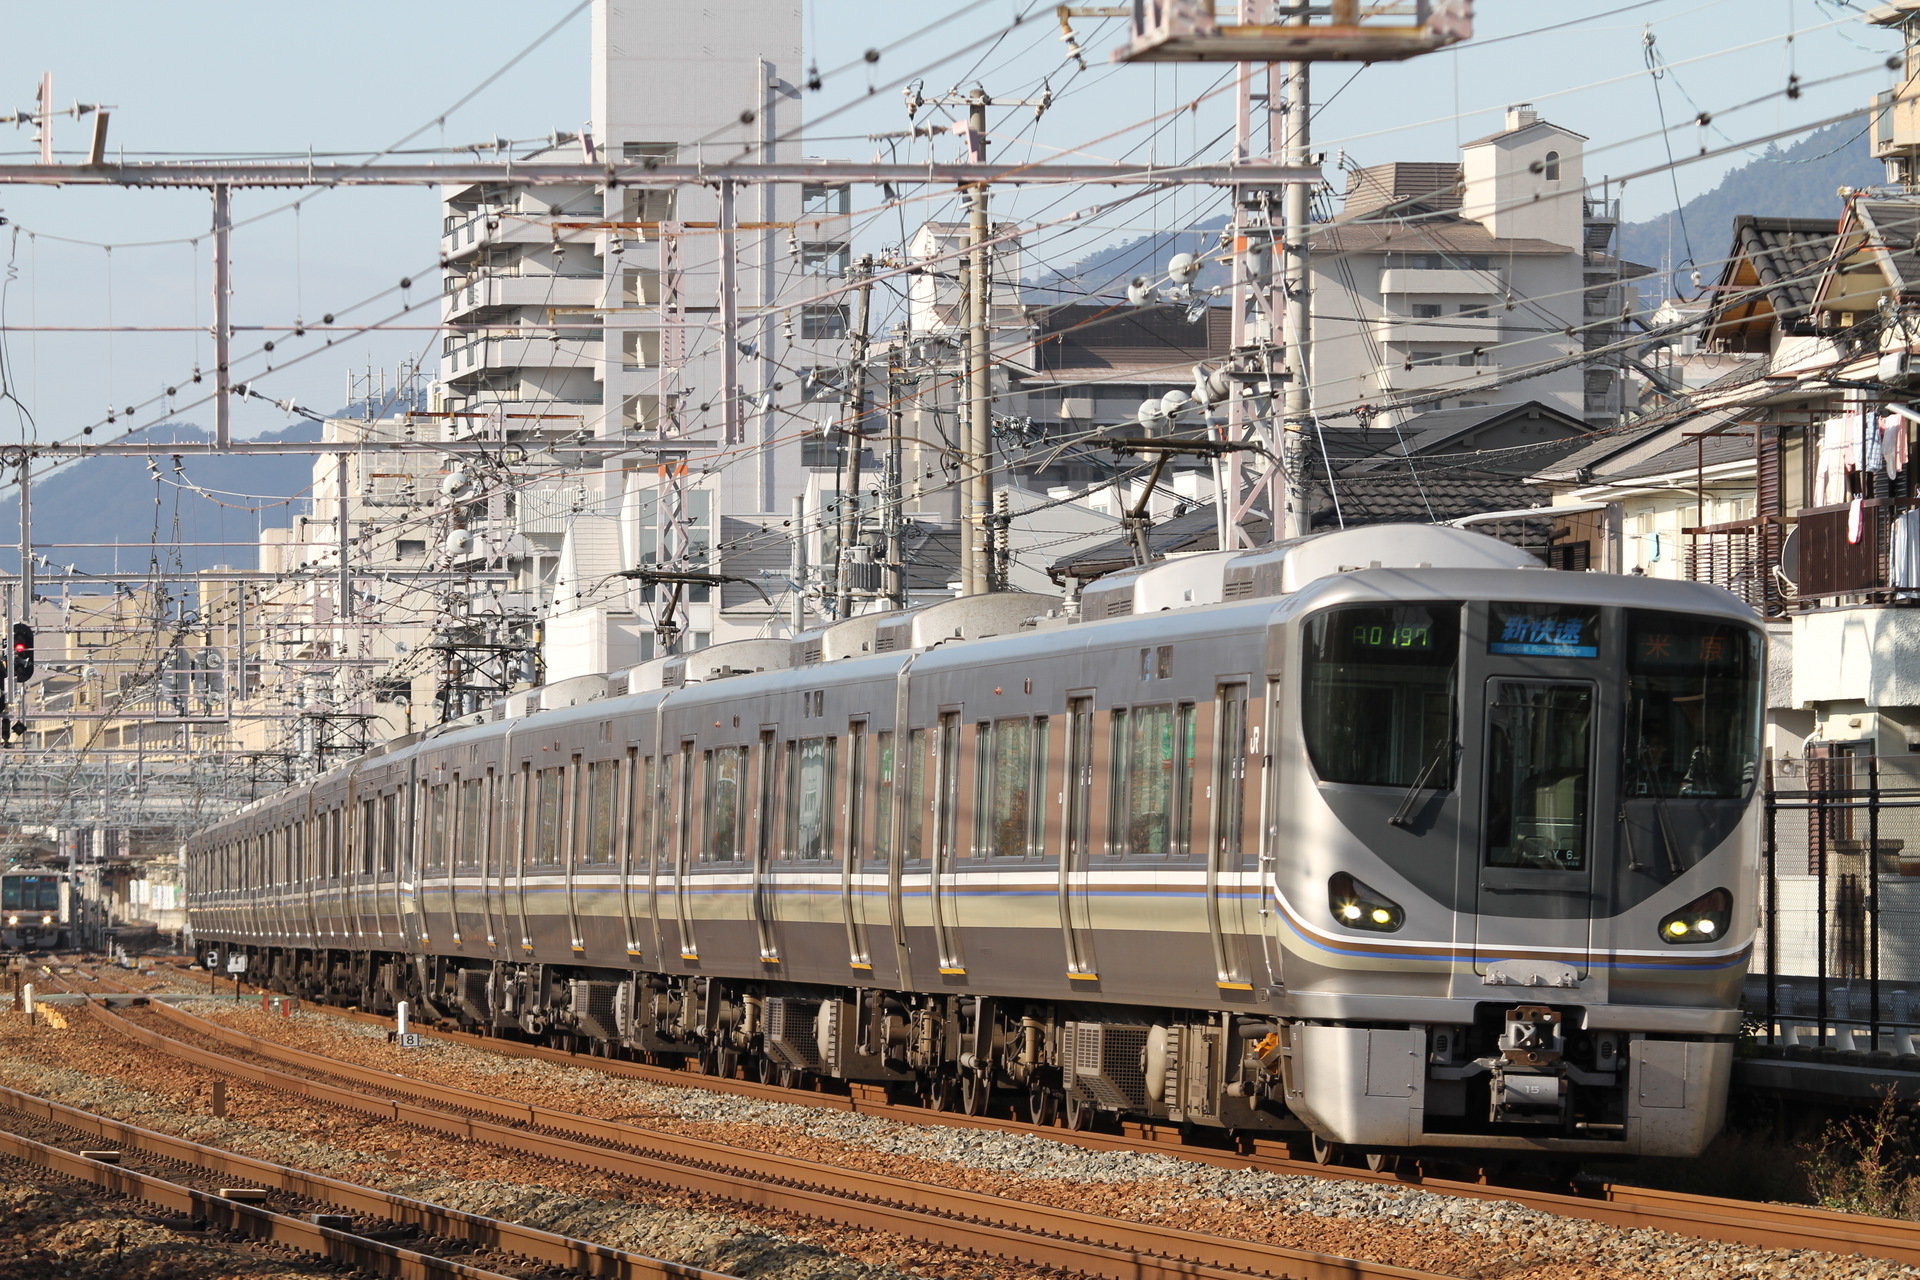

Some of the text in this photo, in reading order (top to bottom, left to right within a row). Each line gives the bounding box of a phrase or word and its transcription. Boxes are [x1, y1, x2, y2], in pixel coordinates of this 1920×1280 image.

[1502, 616, 1583, 644] 新快速
[1643, 633, 1727, 660] 米原
[1250, 726, 1260, 754] JR
[406, 1034, 415, 1045] 8
[1524, 1085, 1540, 1094] 15
